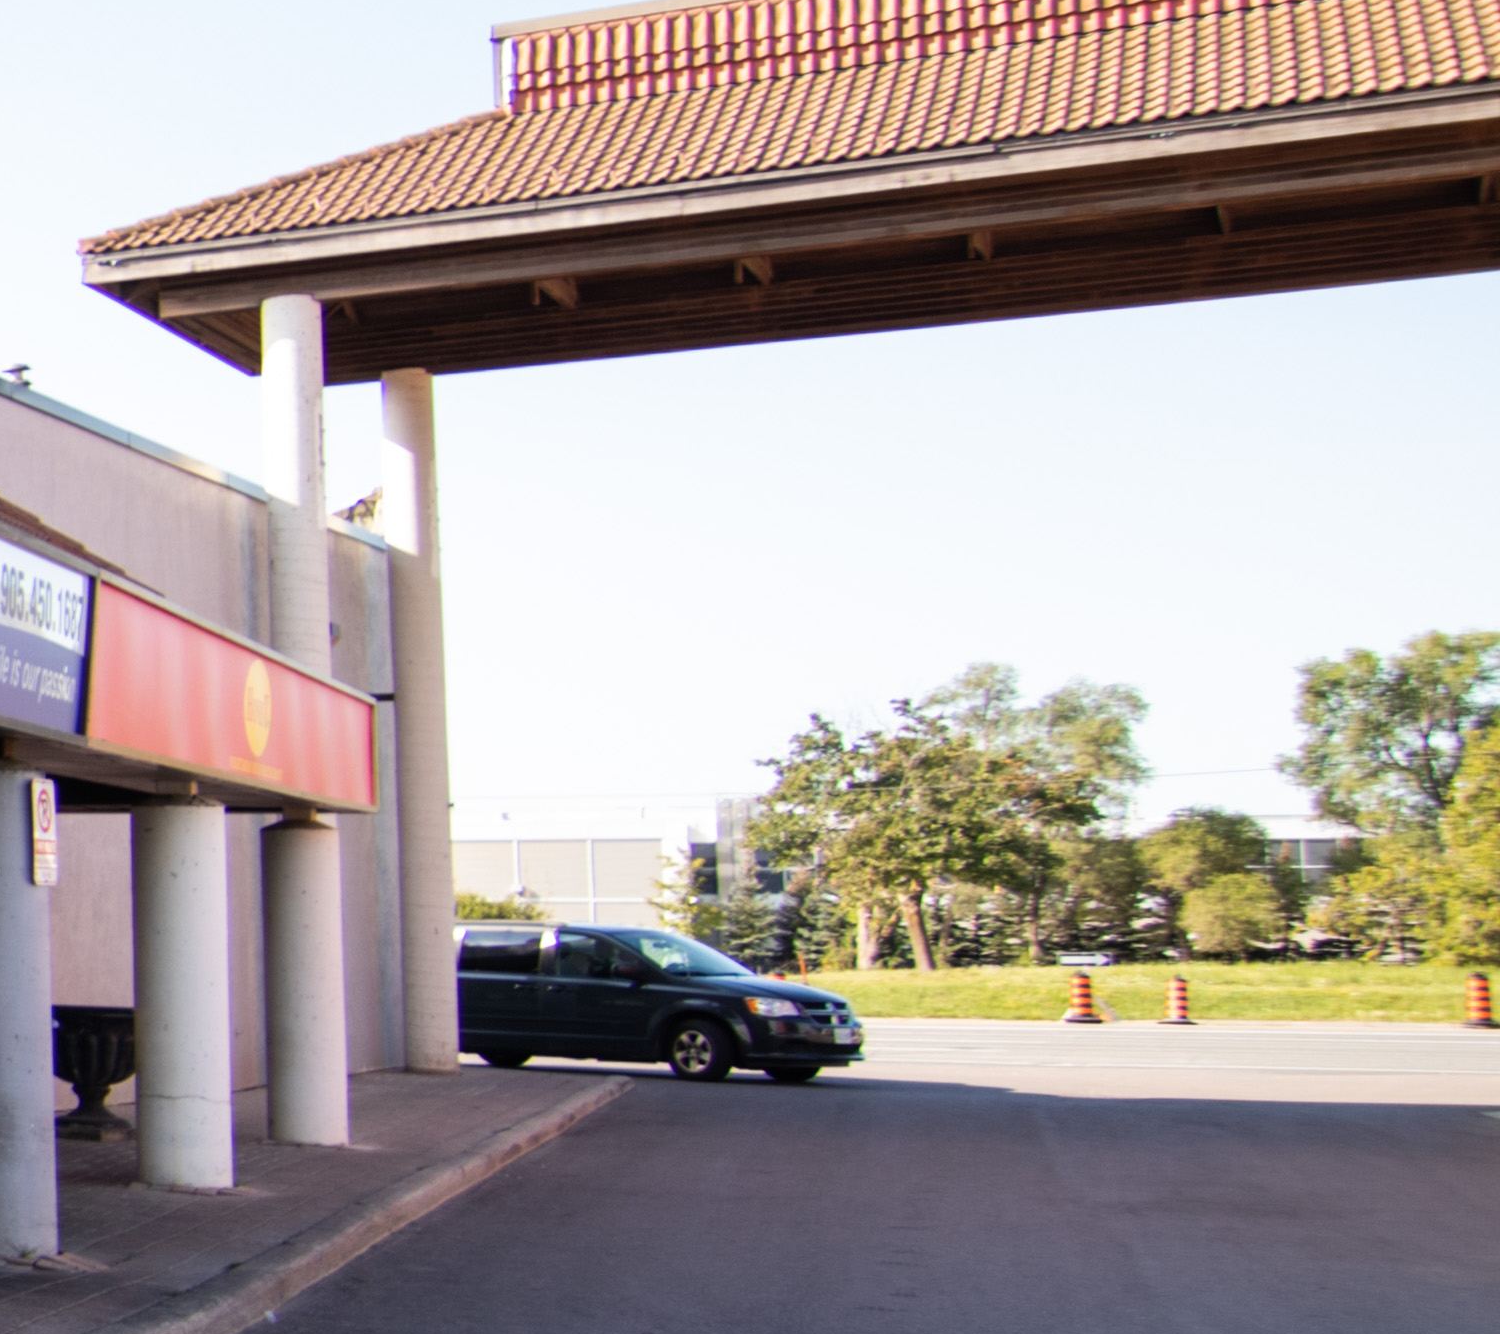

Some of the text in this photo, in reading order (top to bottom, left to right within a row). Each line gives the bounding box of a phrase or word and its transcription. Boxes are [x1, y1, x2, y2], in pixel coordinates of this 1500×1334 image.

[10, 649, 19, 687] is
[21, 662, 41, 692] our
[38, 665, 76, 703] passion
